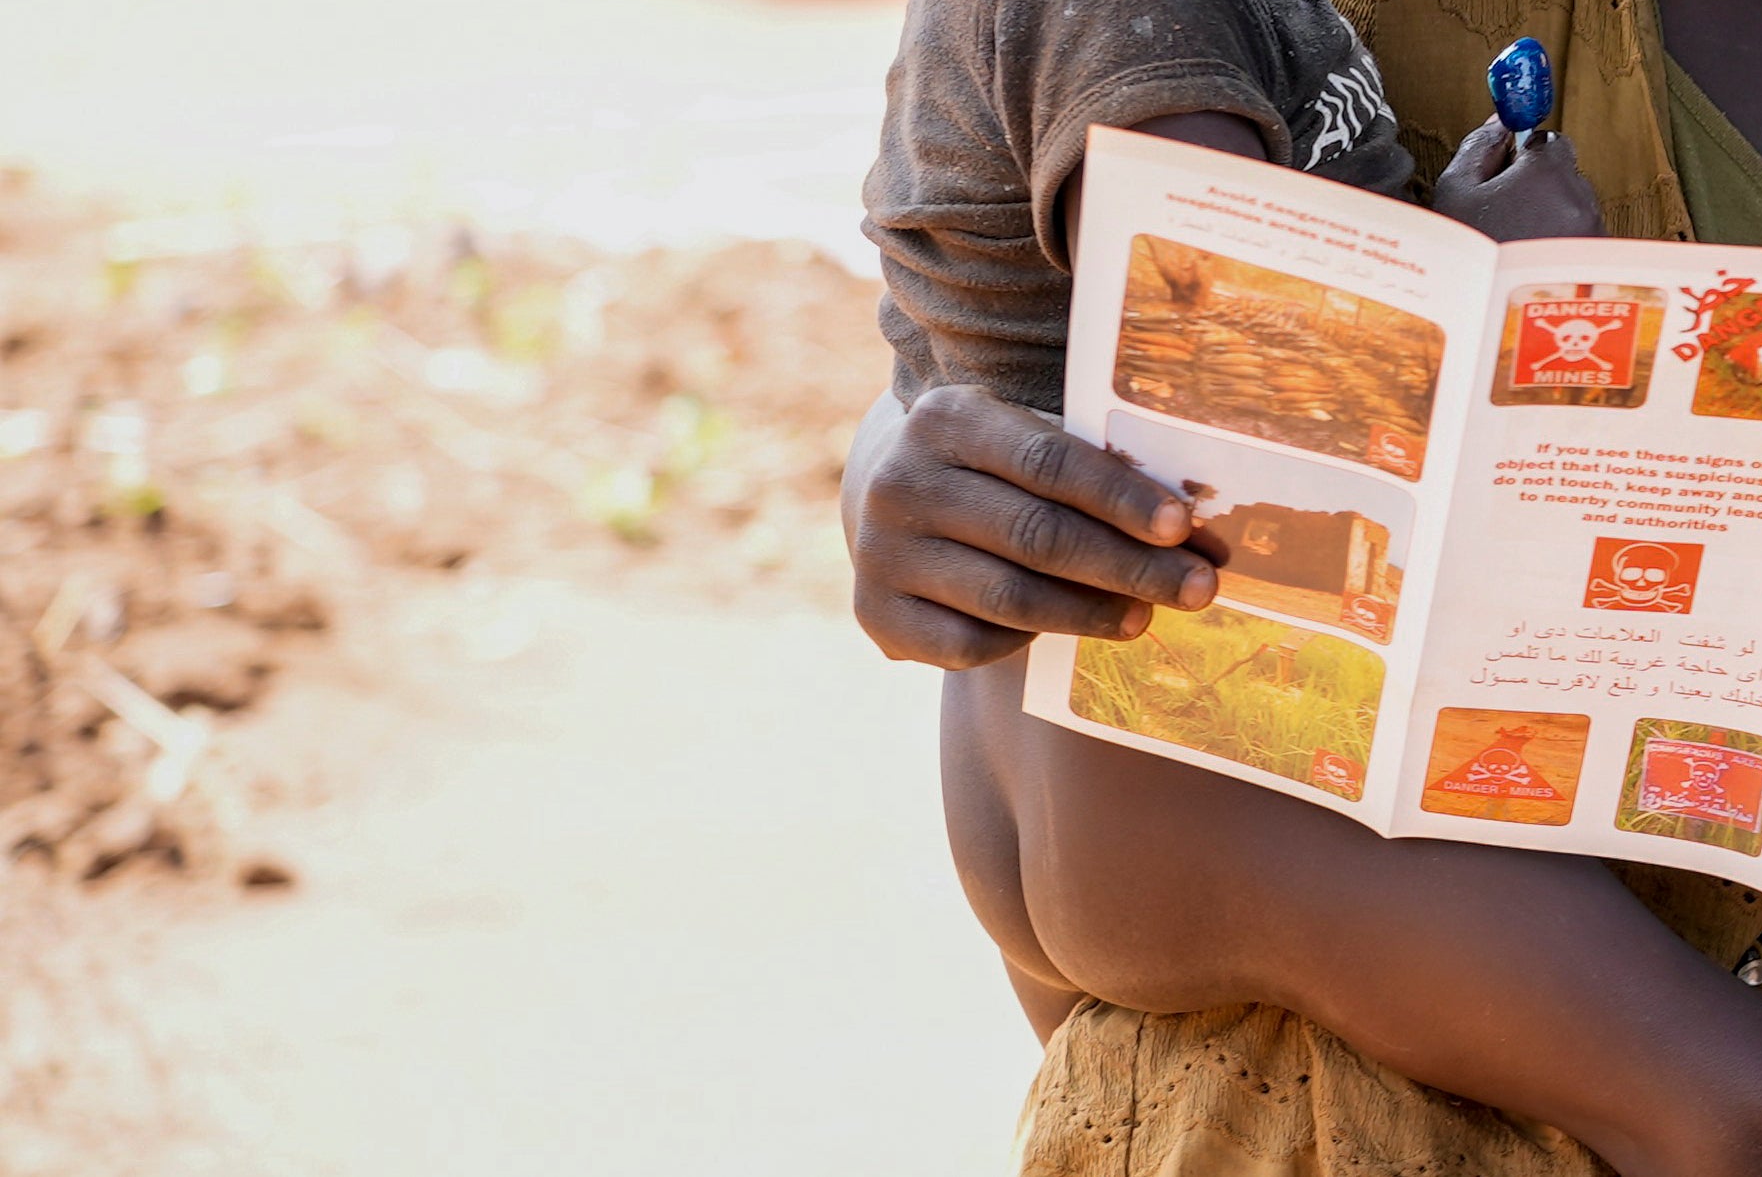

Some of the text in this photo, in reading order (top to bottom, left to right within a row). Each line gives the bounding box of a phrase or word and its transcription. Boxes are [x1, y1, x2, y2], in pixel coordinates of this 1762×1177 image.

[1323, 237, 1357, 251] and
[1366, 232, 1399, 248] and
[1526, 301, 1631, 319] DANGER
[1679, 270, 1757, 333] خطر
[1533, 369, 1613, 386] MINES
[1536, 443, 1551, 453] If
[1556, 446, 1590, 456] you
[1596, 449, 1629, 459] see
[1636, 450, 1689, 463] these
[1695, 454, 1745, 468] signs
[1495, 460, 1556, 472] object
[1562, 461, 1600, 473] that
[1606, 464, 1658, 478] looks
[1493, 475, 1516, 486] do
[1522, 476, 1554, 486] not
[1560, 477, 1619, 492] touch,
[1625, 481, 1672, 496] keep
[1678, 488, 1726, 501] away
[1519, 492, 1538, 502] to
[1544, 493, 1610, 508] nearby
[1616, 498, 1720, 517] community
[1582, 513, 1728, 532] and authorities
[1574, 626, 1661, 643] العلامات
[1678, 634, 1726, 649] شفت
[1485, 644, 1540, 661] تلمس
[1548, 647, 1568, 661] ما
[1734, 639, 1756, 657] لو
[1676, 655, 1728, 675] حاجة
[1537, 673, 1600, 691] لاقرب
[1607, 675, 1638, 697] بلغ
[1647, 685, 1660, 697] و
[1669, 680, 1713, 702] بعيدا
[1443, 780, 1499, 794] DANGER
[1510, 786, 1554, 798] MINES
